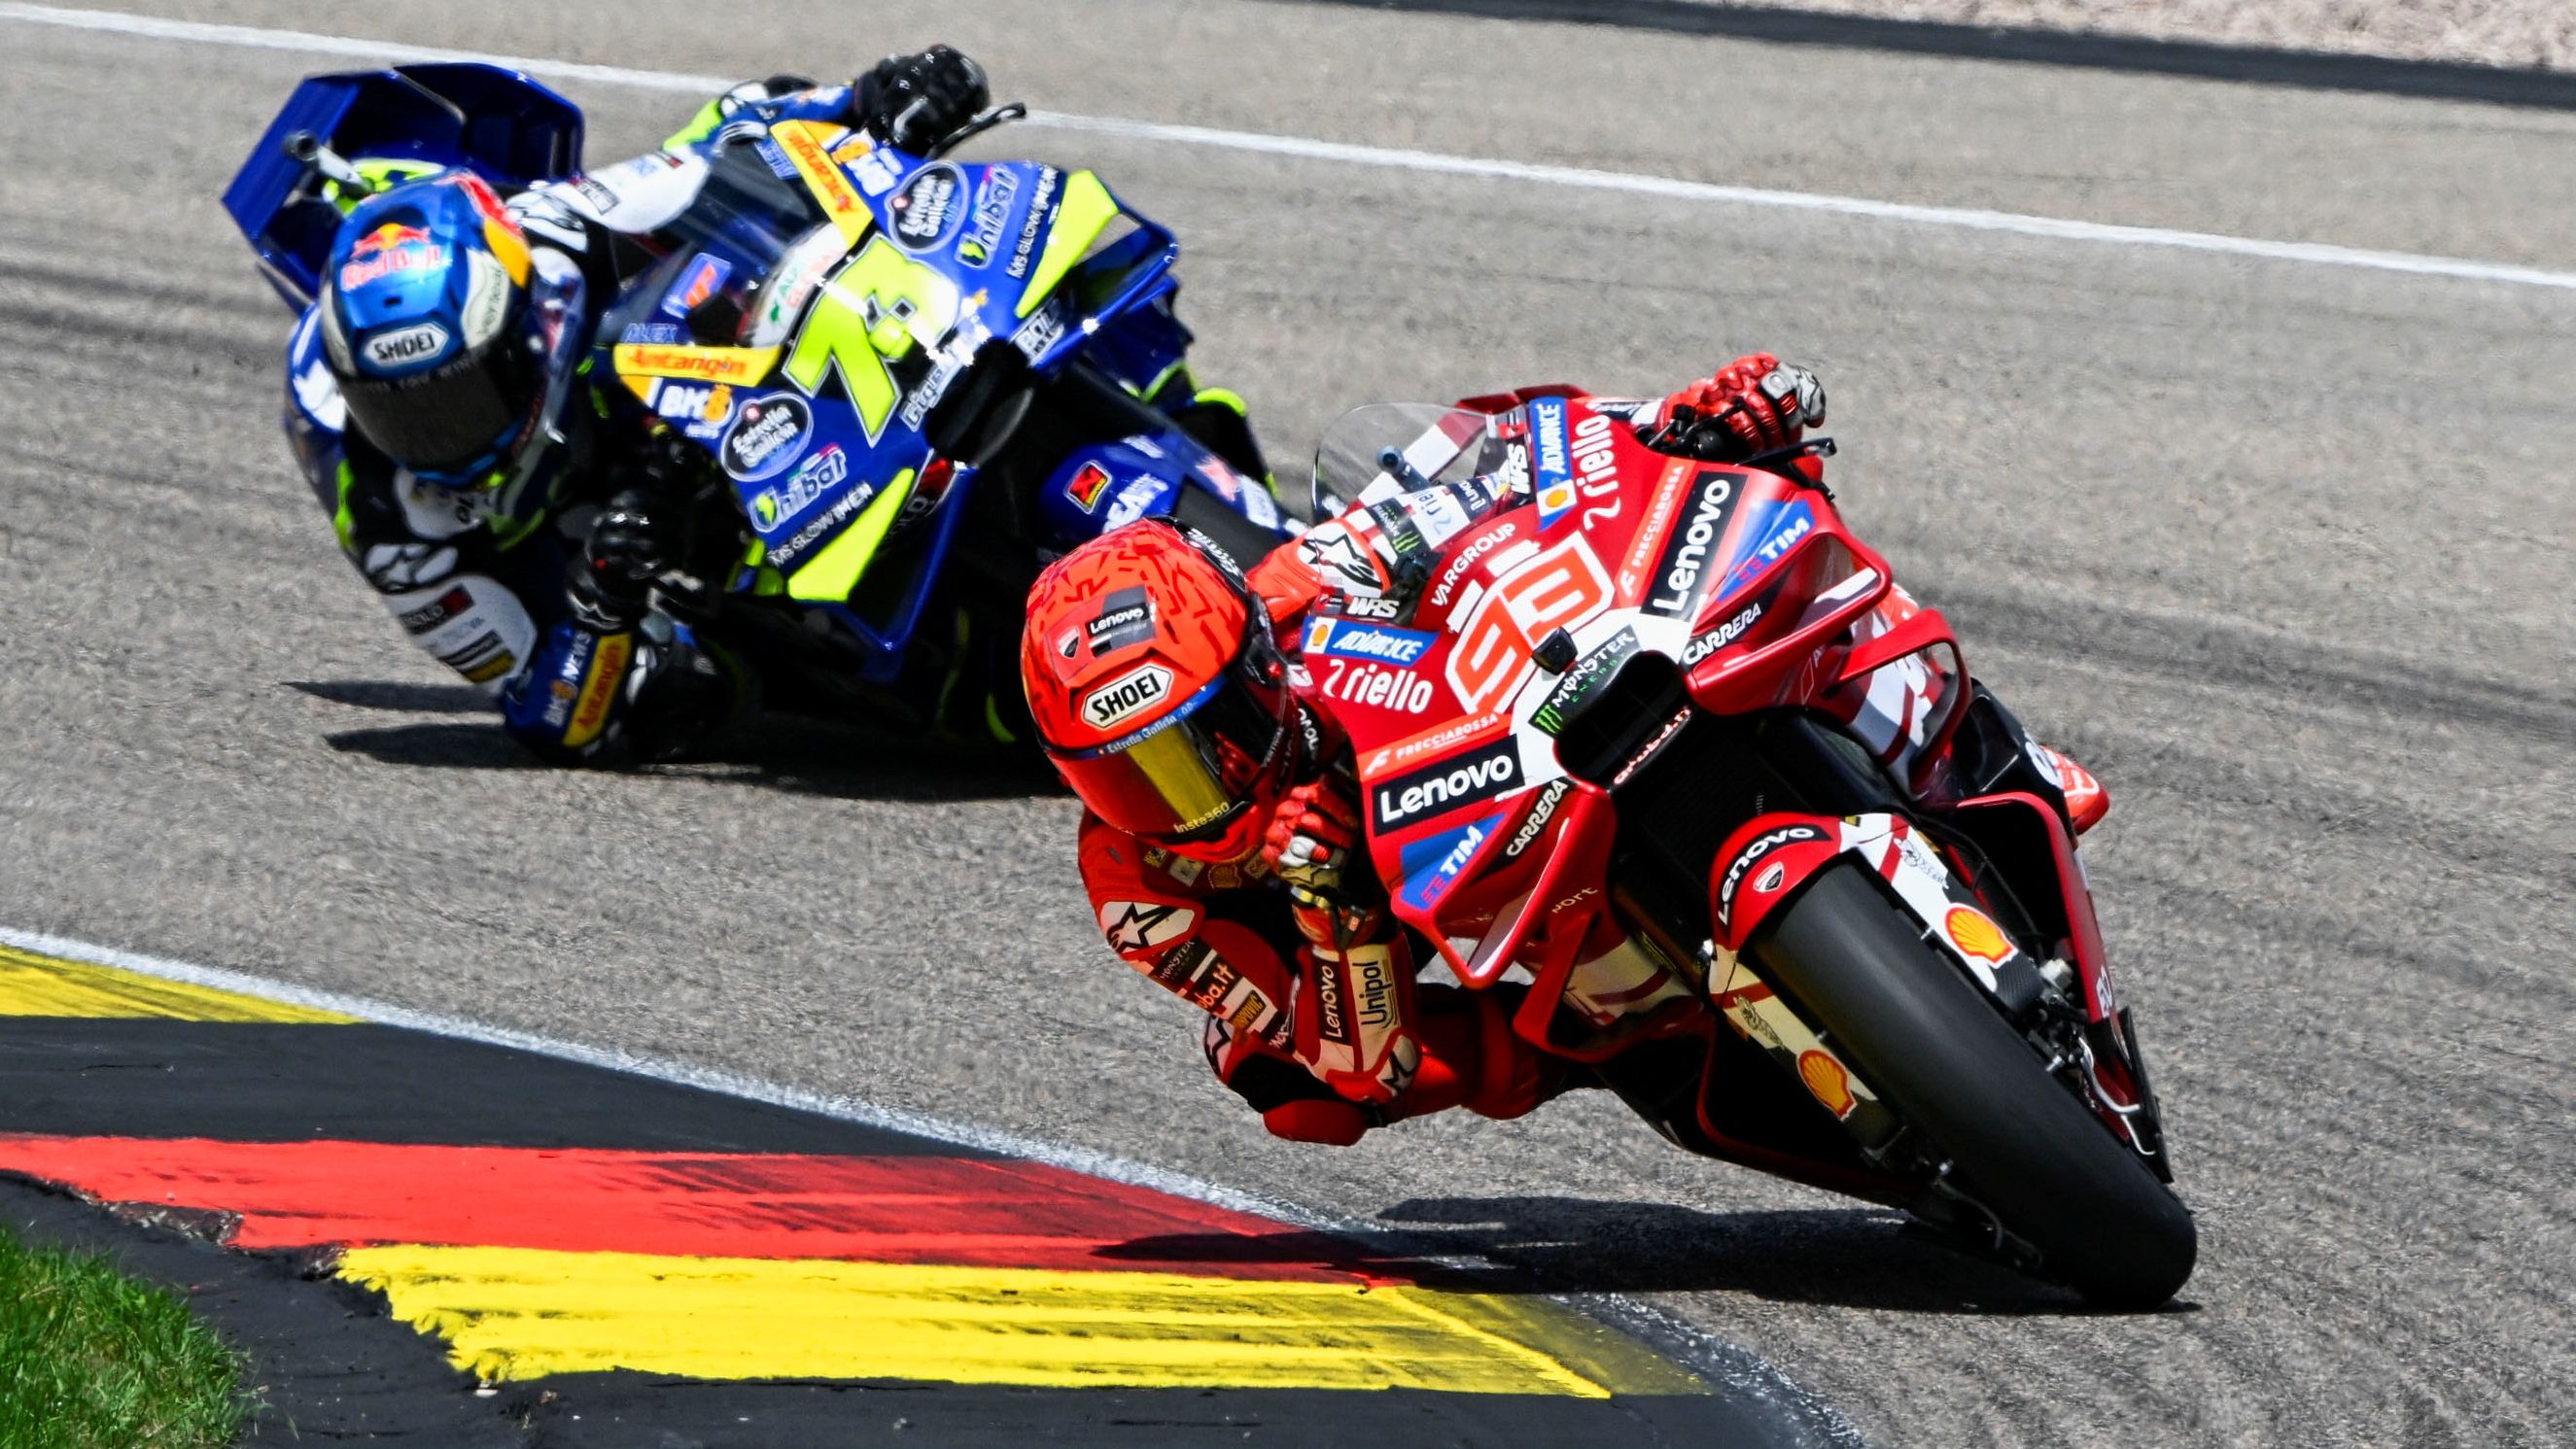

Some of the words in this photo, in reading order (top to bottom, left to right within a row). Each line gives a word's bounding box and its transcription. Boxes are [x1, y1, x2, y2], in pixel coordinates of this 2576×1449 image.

[373, 330, 435, 362] SHOEI
[1536, 402, 1566, 475] ADVANCE
[1571, 414, 1619, 498] riello
[1632, 466, 1686, 568] FRECCIAROSSA
[1653, 479, 1730, 611] Lenovo
[1759, 517, 1811, 561] TIM
[1430, 522, 1516, 607] VARGROUP
[1089, 606, 1144, 635] Lenovo
[1347, 596, 1399, 618] WRS
[1447, 533, 1612, 715] 93
[1683, 603, 1762, 666] CARRERA
[1332, 630, 1423, 662] ADVANCE
[1551, 632, 1635, 707] MONSTER
[1092, 673, 1162, 722] SHOEI
[1340, 663, 1434, 715] riello
[1106, 733, 1144, 755] Estrella
[1141, 715, 1177, 739] Galicia
[1395, 714, 1499, 759] FRECCIAROSSA
[1173, 802, 1231, 834] Insta360
[1379, 754, 1514, 823] Lenovo
[1506, 779, 1568, 857] CARRERA
[1439, 825, 1484, 876] TIM
[1718, 827, 1815, 926] Lenovo
[1321, 965, 1342, 1039] Lenovo
[1352, 960, 1392, 1025] Unipol
